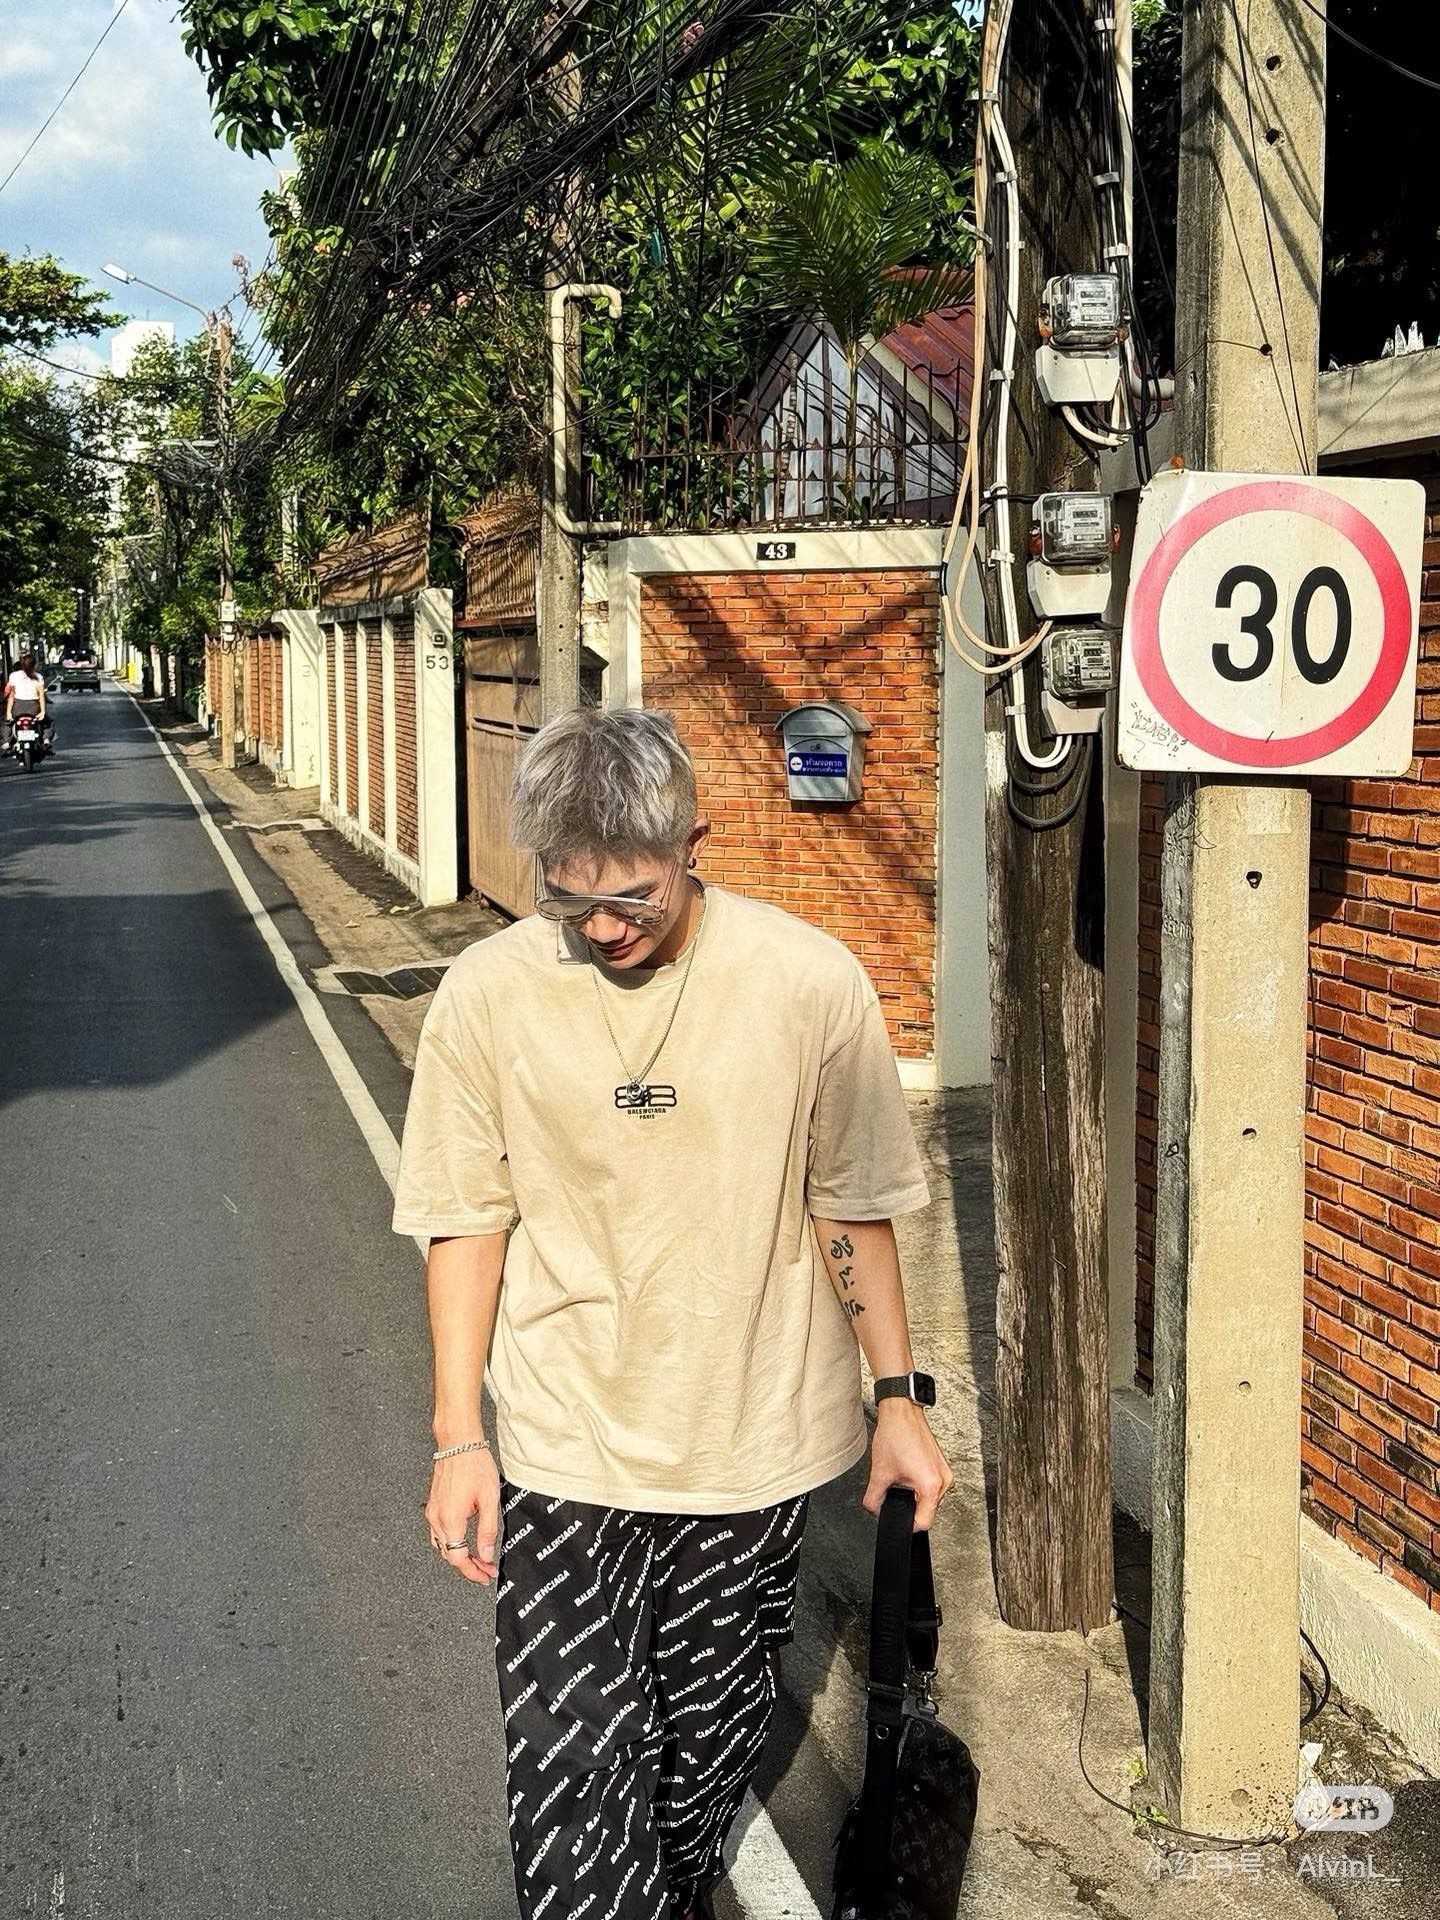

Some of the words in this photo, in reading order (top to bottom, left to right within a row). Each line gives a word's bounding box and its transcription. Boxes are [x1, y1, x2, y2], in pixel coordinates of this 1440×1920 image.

[765, 543, 788, 559] 43
[1211, 564, 1352, 685] 30
[426, 655, 449, 670] 53
[733, 1507, 781, 1565] BALENCIAGA
[518, 1569, 570, 1619] BALENCIAGA
[506, 1620, 556, 1673] BALENCIAGA
[558, 1615, 609, 1658] BALENCIAGA
[591, 1700, 638, 1756] BALENCIAGA
